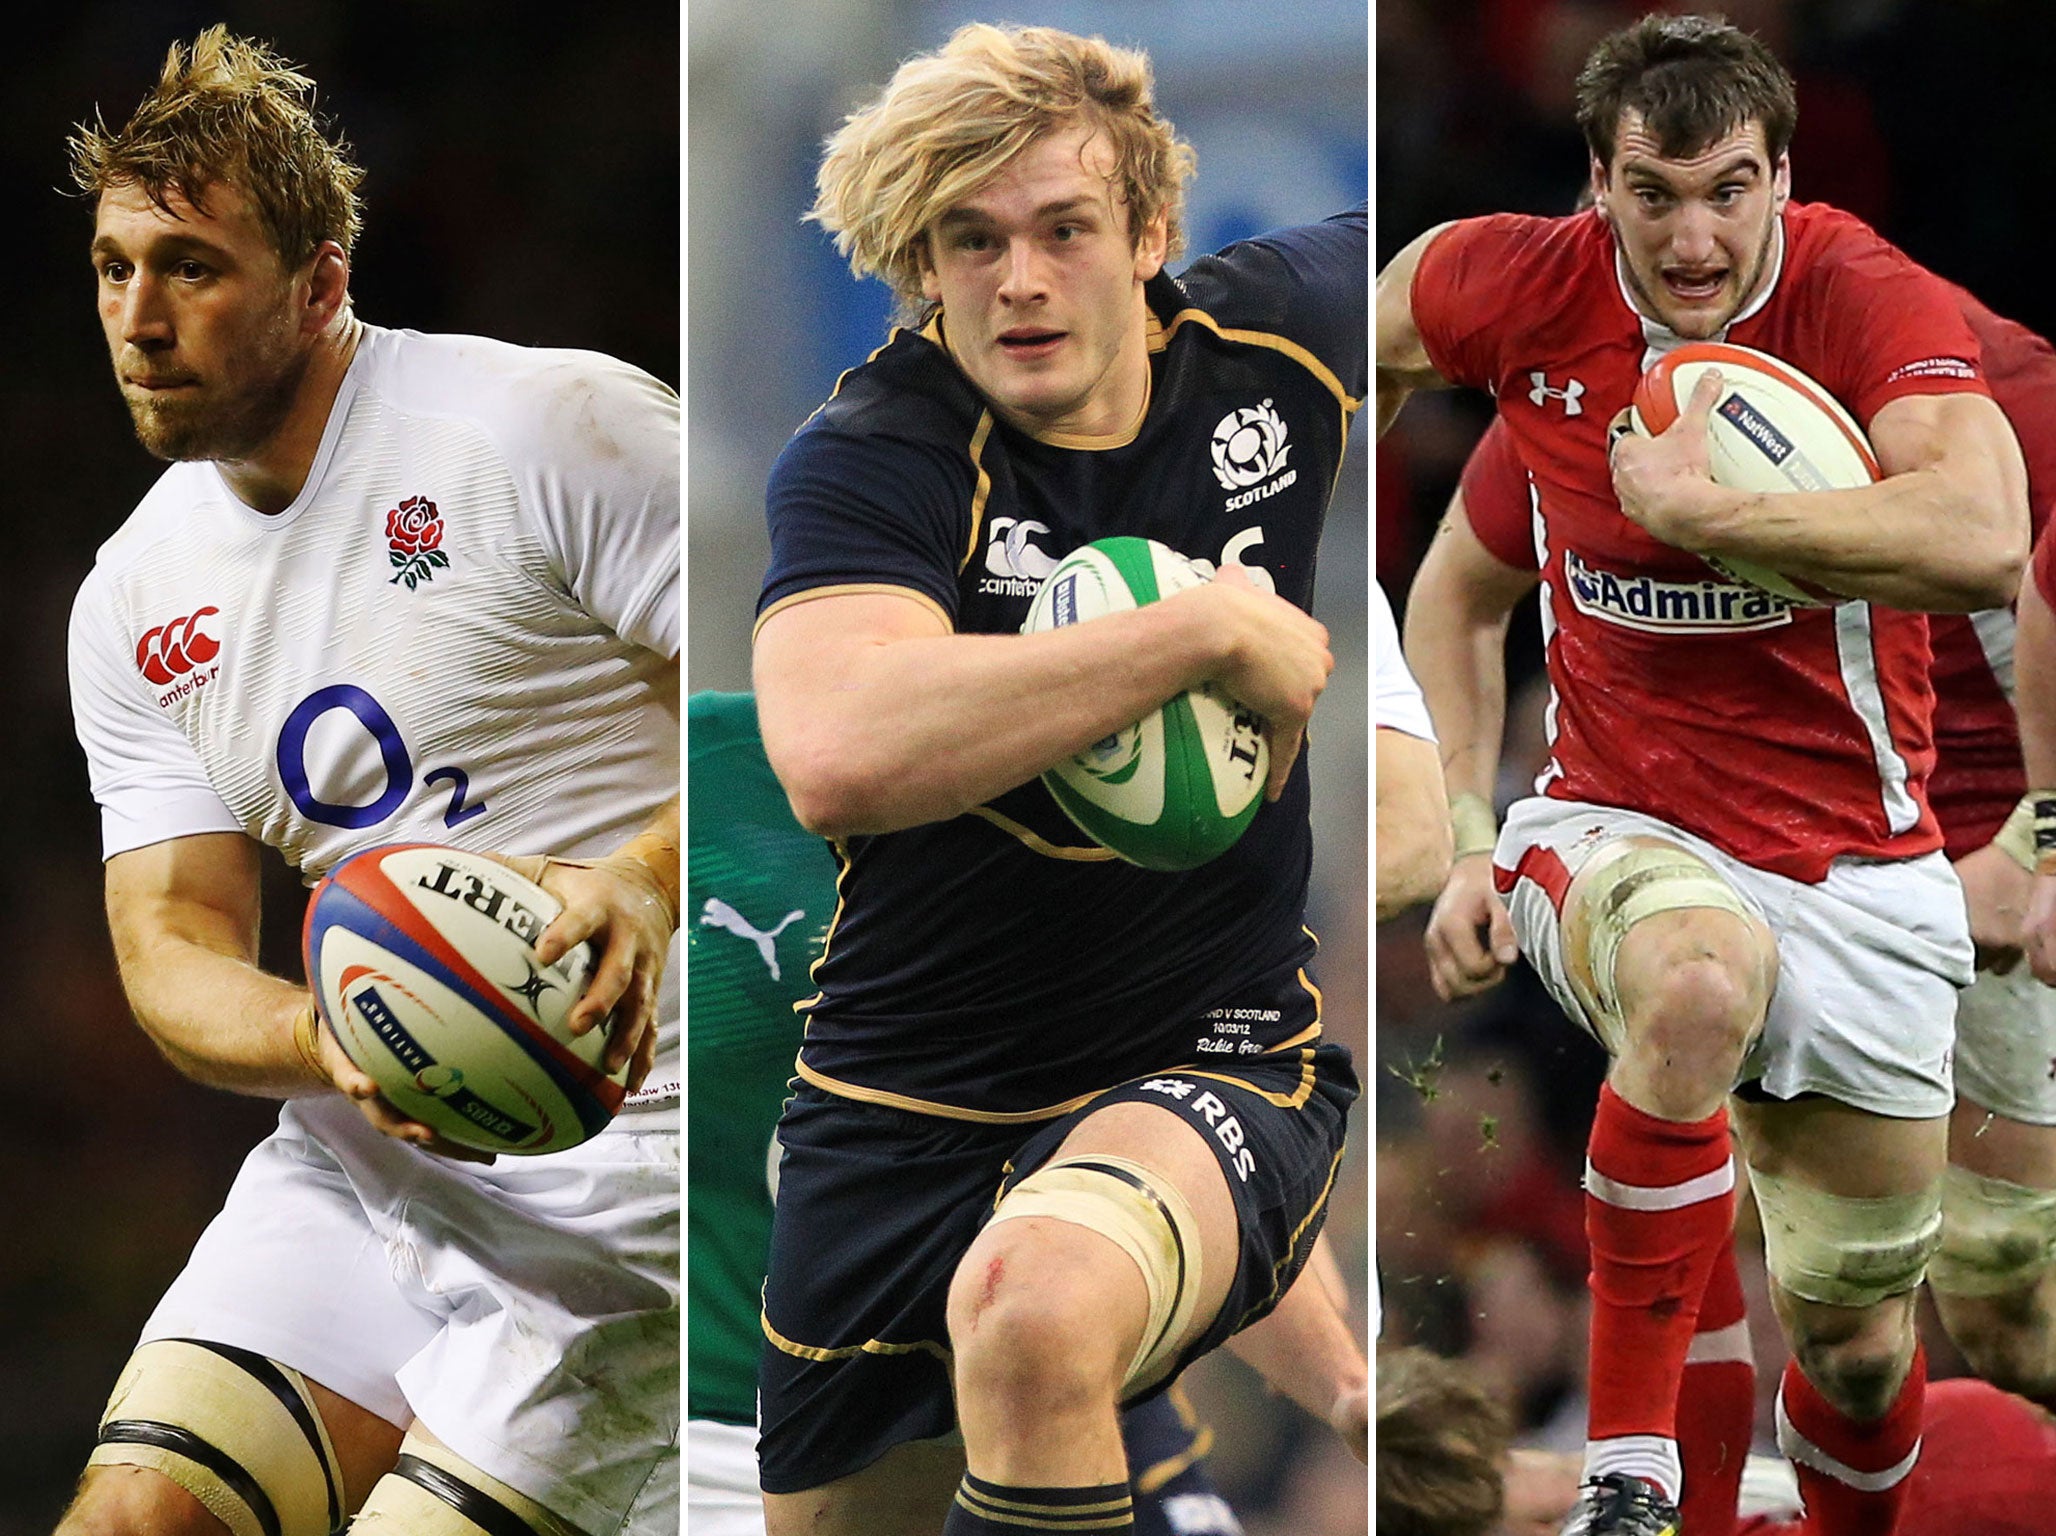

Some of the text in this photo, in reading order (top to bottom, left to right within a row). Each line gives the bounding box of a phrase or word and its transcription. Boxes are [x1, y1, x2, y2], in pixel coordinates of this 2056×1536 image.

[1738, 410, 1787, 458] NatWest
[1225, 469, 1297, 512] SCOTLAND
[365, 1002, 422, 1066] NATIONS
[1213, 1023, 1251, 1035] 10/03/12
[1225, 1009, 1232, 1019] V
[1233, 1009, 1281, 1021] SCOTLAND
[1191, 1090, 1256, 1183] RBS
